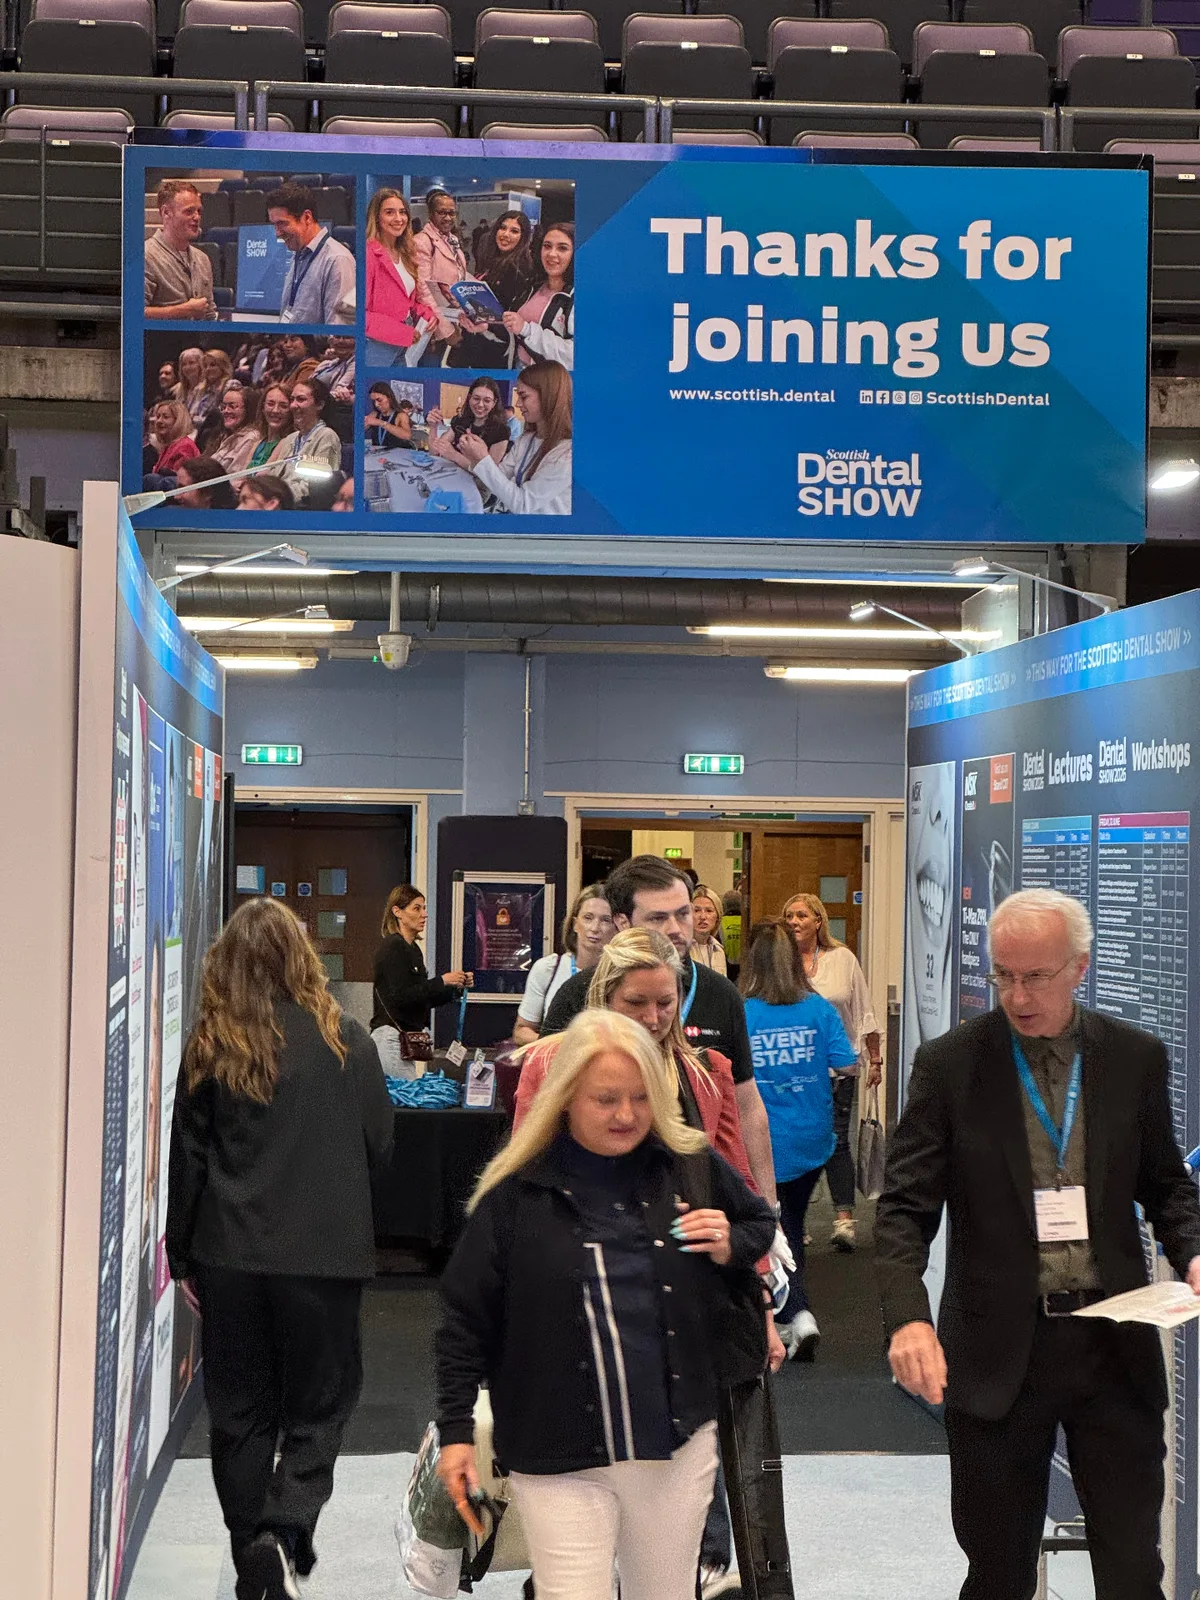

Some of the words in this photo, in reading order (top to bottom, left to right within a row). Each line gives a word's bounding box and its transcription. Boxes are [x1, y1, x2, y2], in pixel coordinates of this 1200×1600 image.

[246, 249, 267, 258] SHOW
[650, 216, 940, 279] Thanks
[958, 219, 1073, 281] for
[668, 302, 940, 379] joining
[961, 321, 1051, 368] us
[669, 388, 836, 404] www.scottish.dental
[926, 391, 1050, 406] ScottishDental
[825, 448, 870, 462] Scottish
[797, 453, 922, 487] Dental
[797, 487, 922, 517] SHOW
[1032, 662, 1045, 682] THIS
[1045, 658, 1060, 678] WAY
[1060, 654, 1074, 675] FOR
[1074, 650, 1087, 672] THE
[1087, 641, 1123, 669] SCOTTISH
[1124, 634, 1154, 661] DENTAL
[1155, 627, 1181, 654] SHOW
[1023, 748, 1045, 776] Dental
[1048, 751, 1093, 785] Lectures
[1099, 736, 1127, 767] Dental
[1132, 738, 1191, 773] Workshops
[965, 772, 978, 797] NSK
[750, 1029, 818, 1051] EVENT
[752, 1045, 816, 1068] STAFF
